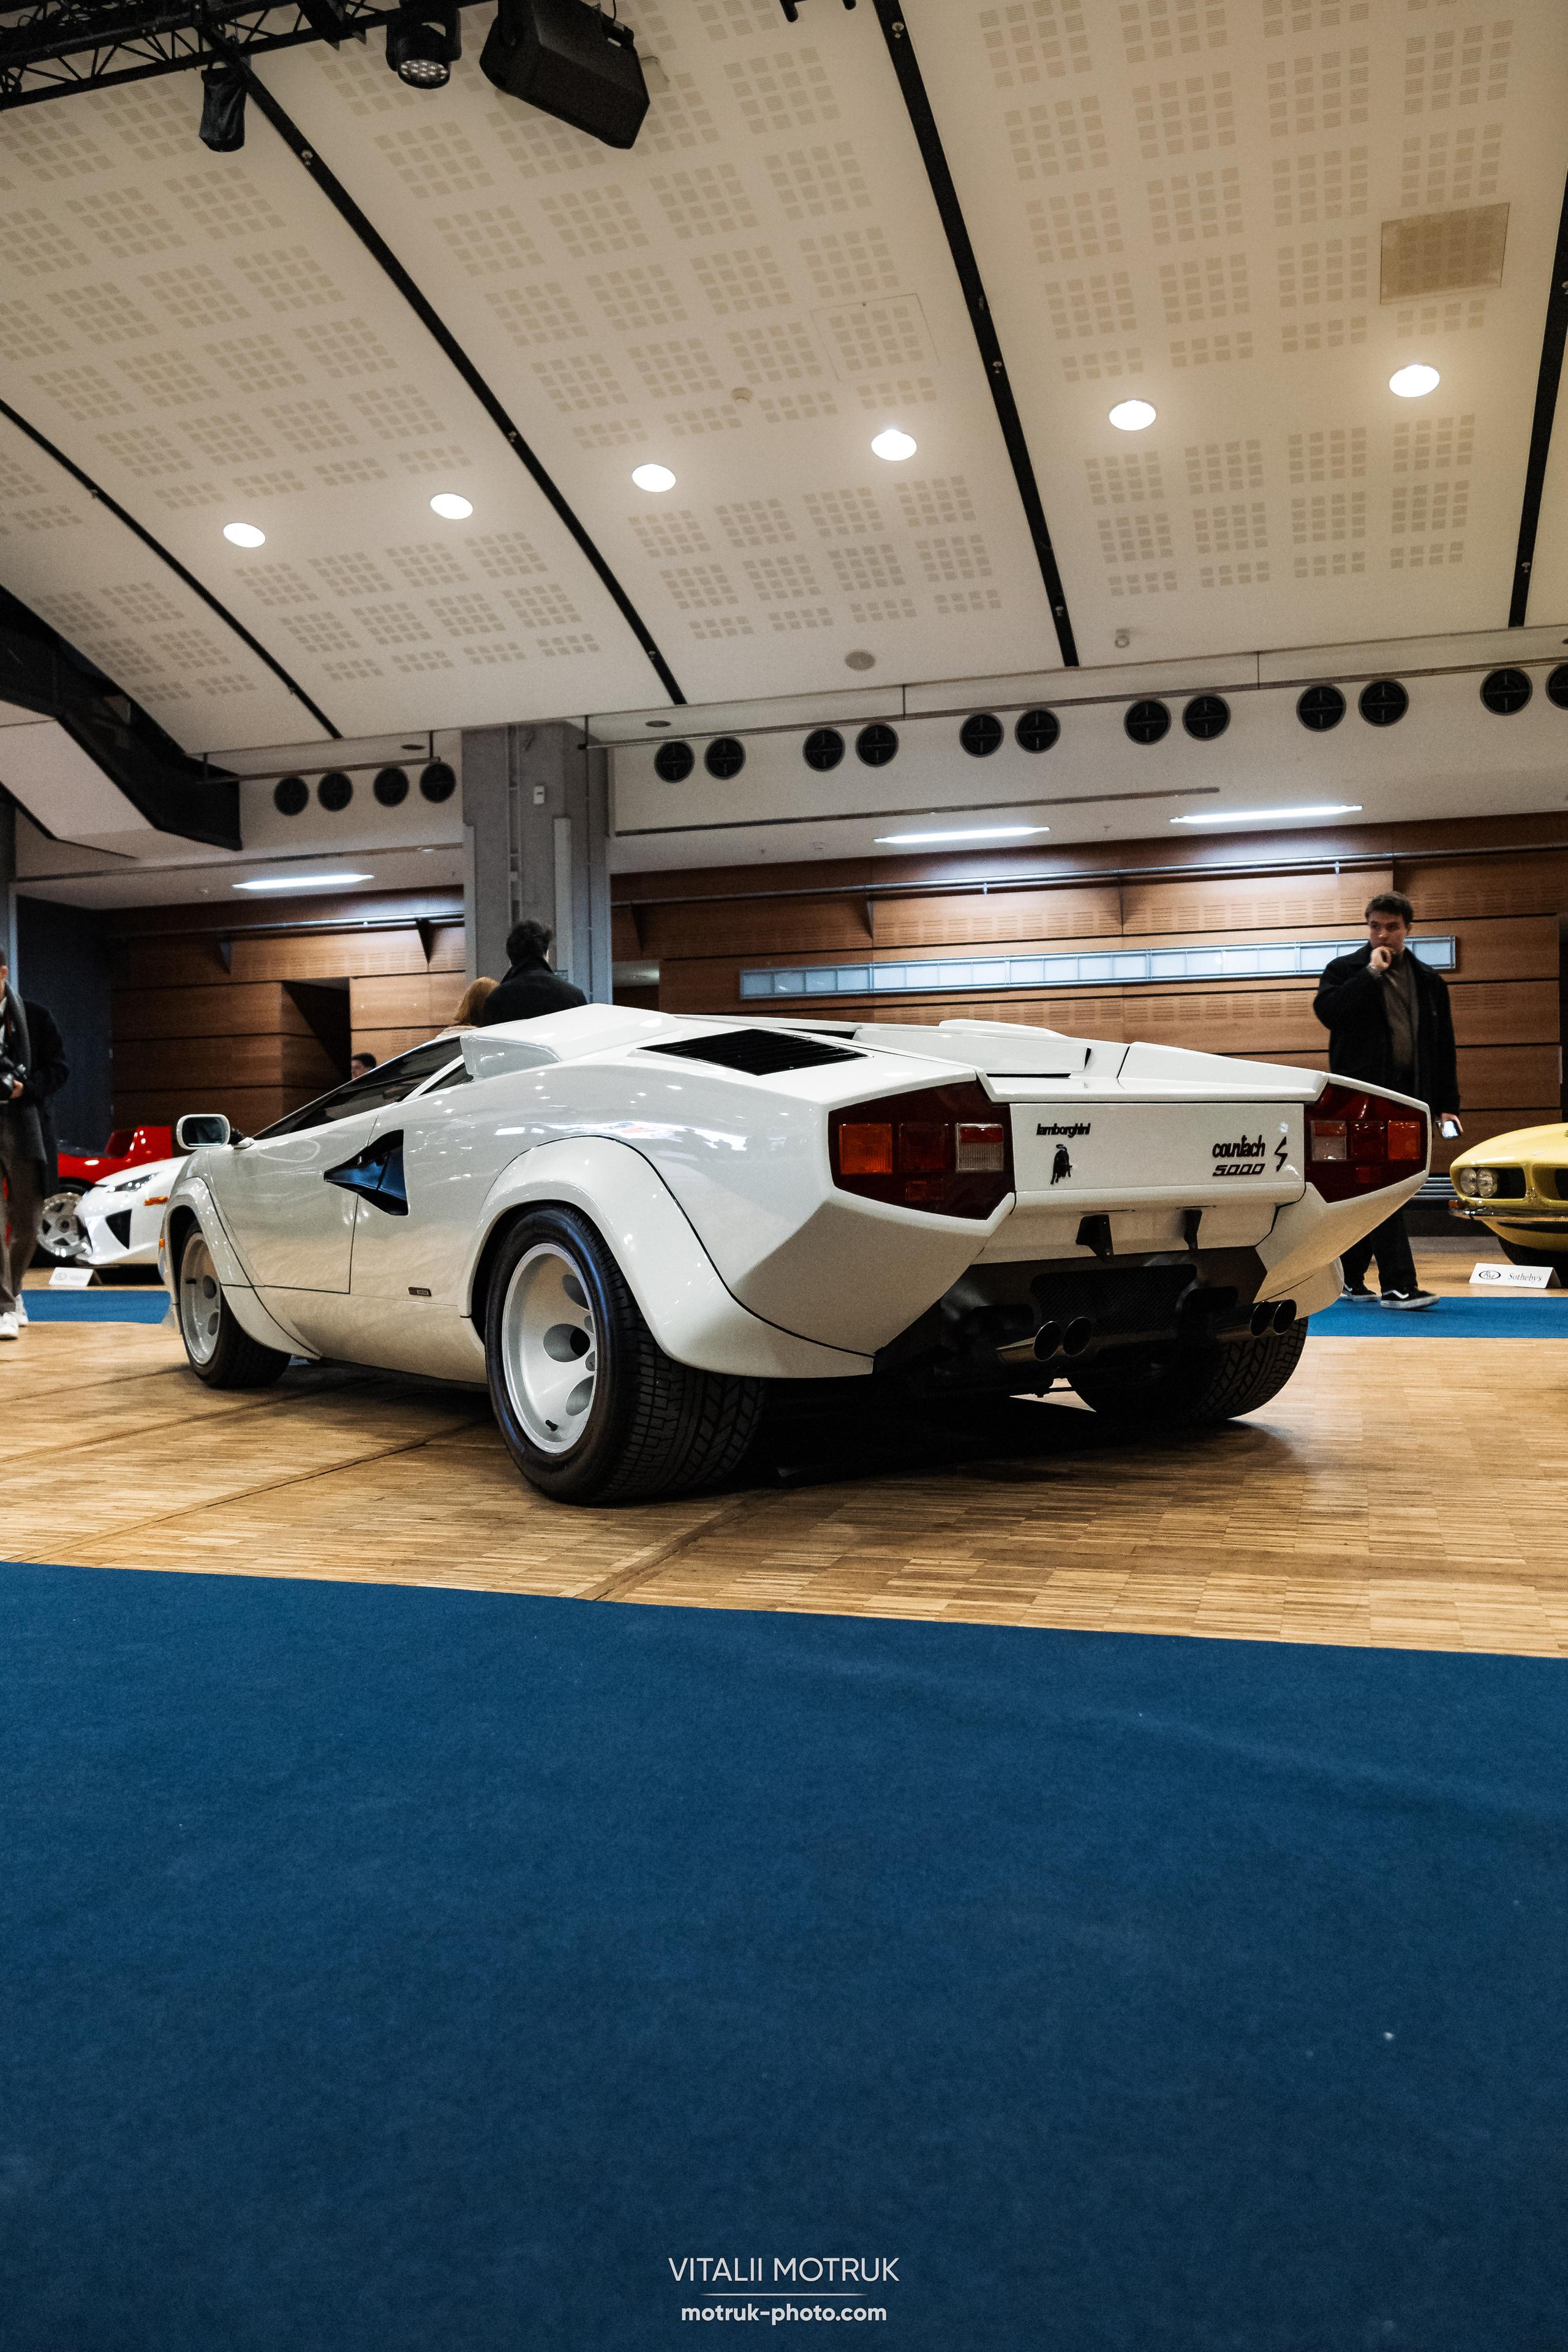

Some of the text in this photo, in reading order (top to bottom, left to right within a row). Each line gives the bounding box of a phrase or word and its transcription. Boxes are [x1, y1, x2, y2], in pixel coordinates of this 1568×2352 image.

[1036, 1123, 1091, 1138] lamborghini
[1212, 1134, 1265, 1158] countach
[1212, 1163, 1265, 1176] 5000
[1508, 1273, 1543, 1283] Sotheby's
